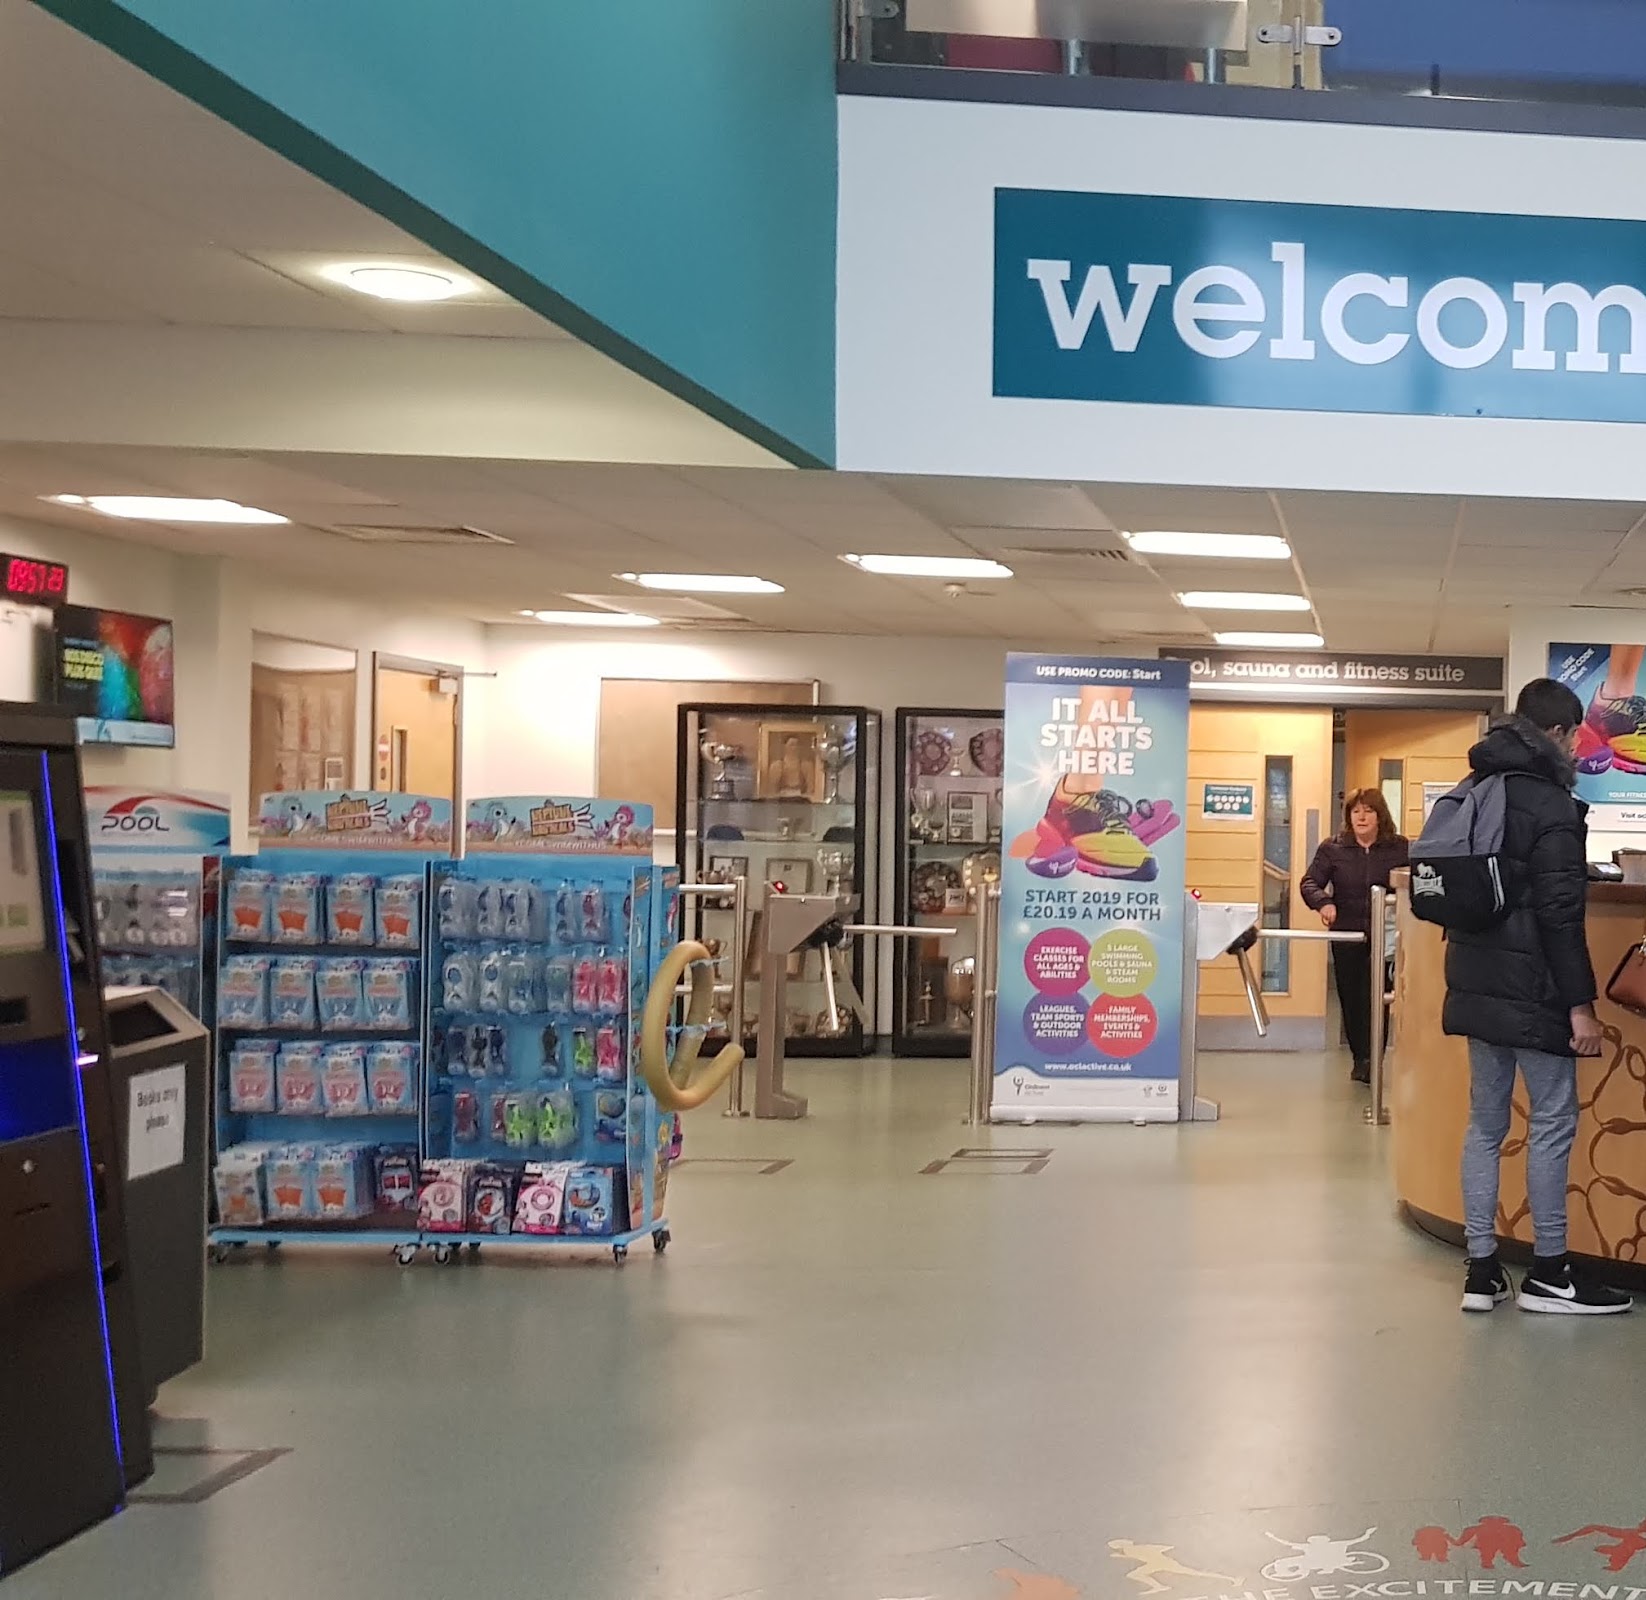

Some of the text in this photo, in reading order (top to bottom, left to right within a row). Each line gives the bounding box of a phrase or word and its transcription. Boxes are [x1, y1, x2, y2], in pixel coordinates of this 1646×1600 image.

[1036, 665, 1161, 680] USE PROMO CODE: Start
[1190, 658, 1465, 682] ol, sauna and fitness suite
[1051, 698, 1144, 724] IT ALL
[1040, 723, 1153, 750] STARTS
[1058, 750, 1135, 775] HERE
[1025, 889, 1160, 905] START 2019 FOR
[1023, 905, 1161, 921] £20.19 A MONTH
[1041, 946, 1077, 954] EXERCISE
[1033, 954, 1084, 963] CLASSES FOR
[1037, 962, 1051, 970] ALL
[1109, 1006, 1136, 1014] FAMILY
[1040, 1021, 1081, 1029] OUTDOOR
[1104, 1022, 1133, 1030] EVENTS
[1036, 1029, 1078, 1037] ACTIVITIES
[1100, 1030, 1142, 1038] ACTIVITIES
